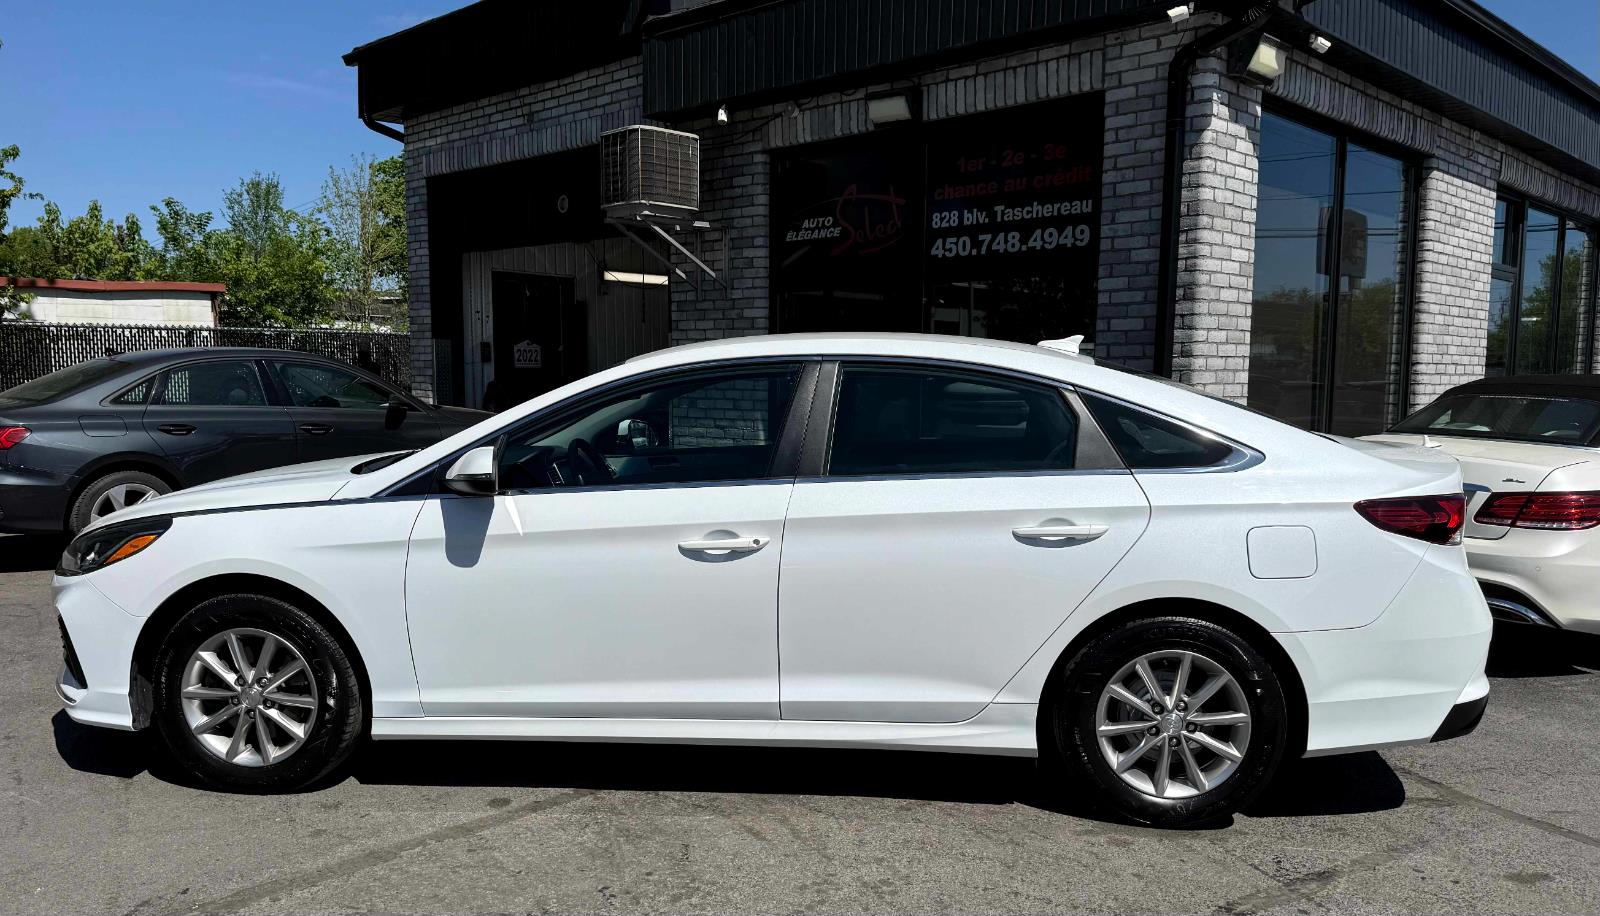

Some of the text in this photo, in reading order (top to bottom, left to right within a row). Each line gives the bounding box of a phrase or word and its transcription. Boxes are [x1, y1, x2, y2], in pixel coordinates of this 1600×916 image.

[957, 156, 987, 174] 1er
[1001, 149, 1025, 168] 2e
[1043, 143, 1068, 161] 3e
[934, 165, 1093, 200] chance au crédit
[802, 216, 833, 229] AUTO
[830, 183, 907, 257] Select
[931, 199, 1093, 229] 828 blv. Taschereau
[785, 227, 842, 242] ÉLÉGANCE
[930, 224, 1091, 258] 450.748.4949
[516, 348, 540, 362] 2022
